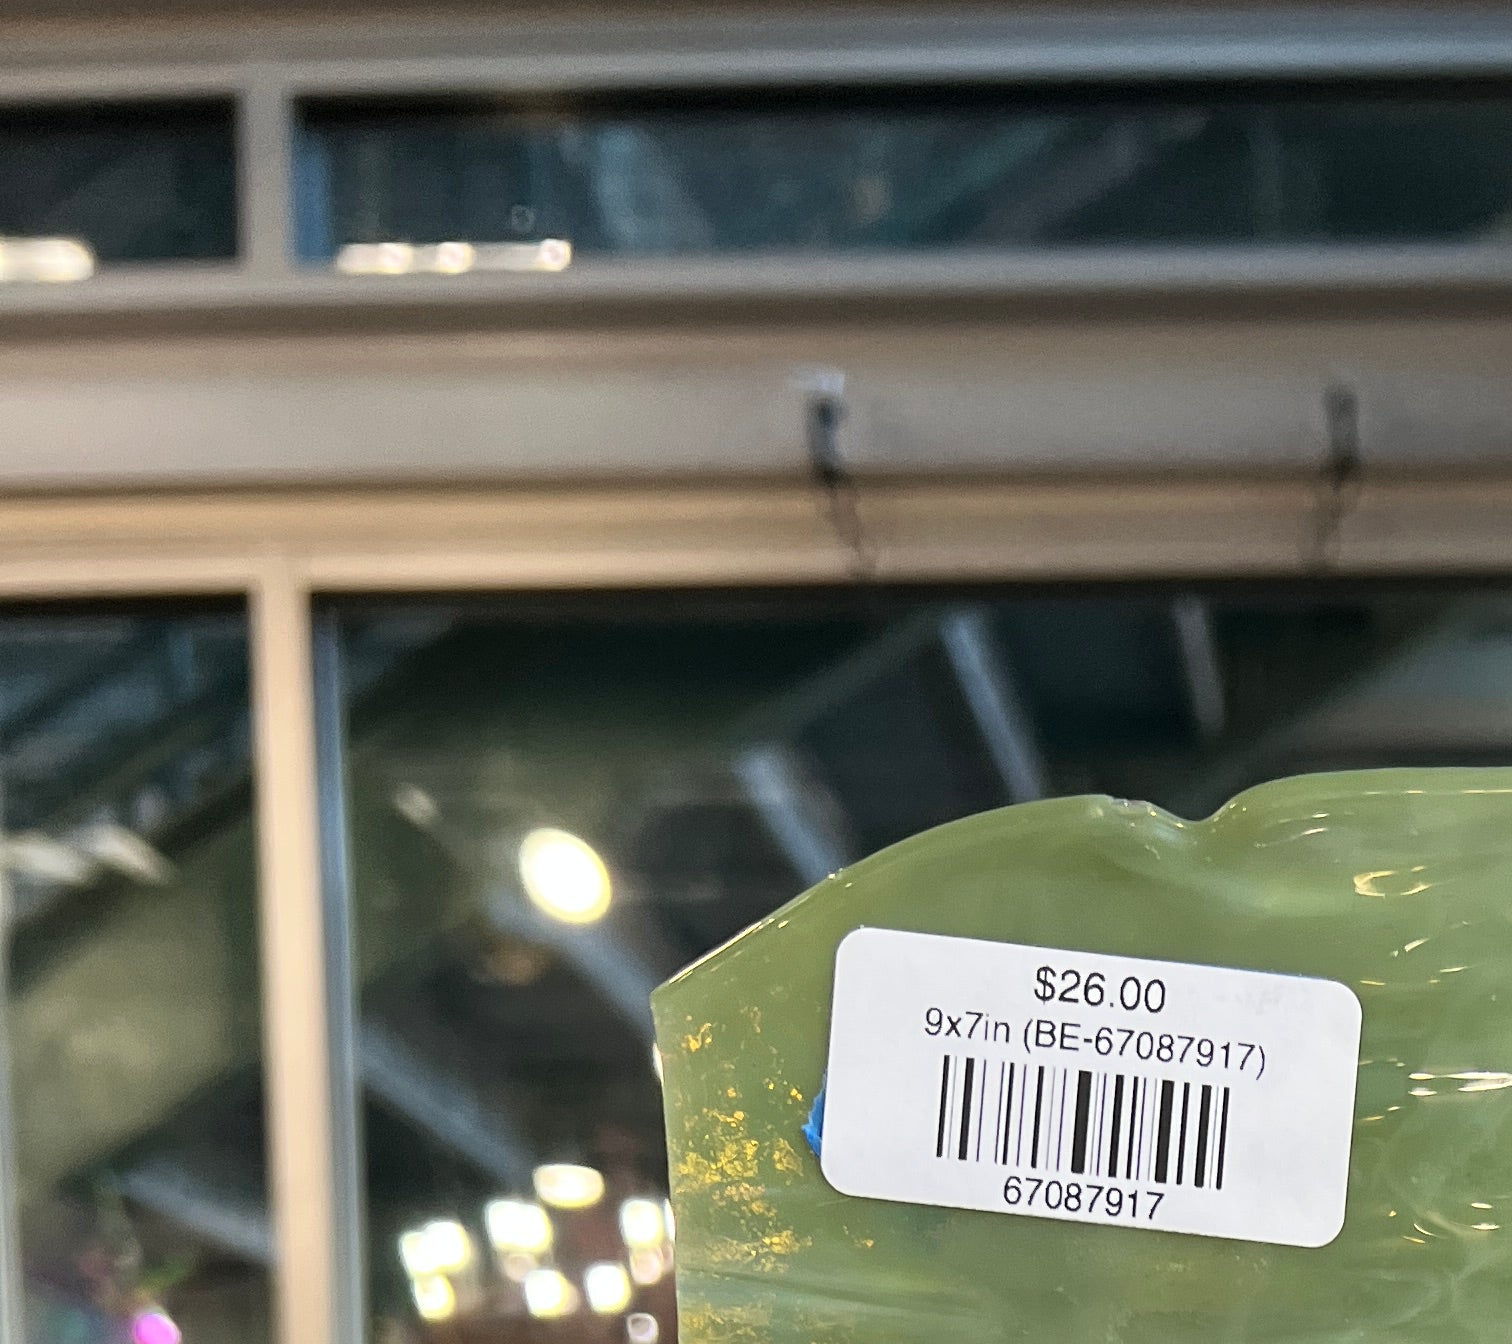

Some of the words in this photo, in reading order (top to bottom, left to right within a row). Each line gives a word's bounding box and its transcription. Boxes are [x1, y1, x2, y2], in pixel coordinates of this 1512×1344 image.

[1034, 965, 1167, 1013] $26.00
[924, 1007, 1010, 1043] 9x7in
[1023, 1018, 1266, 1080] (BE-67087917)
[1003, 1175, 1165, 1221] 67087917
